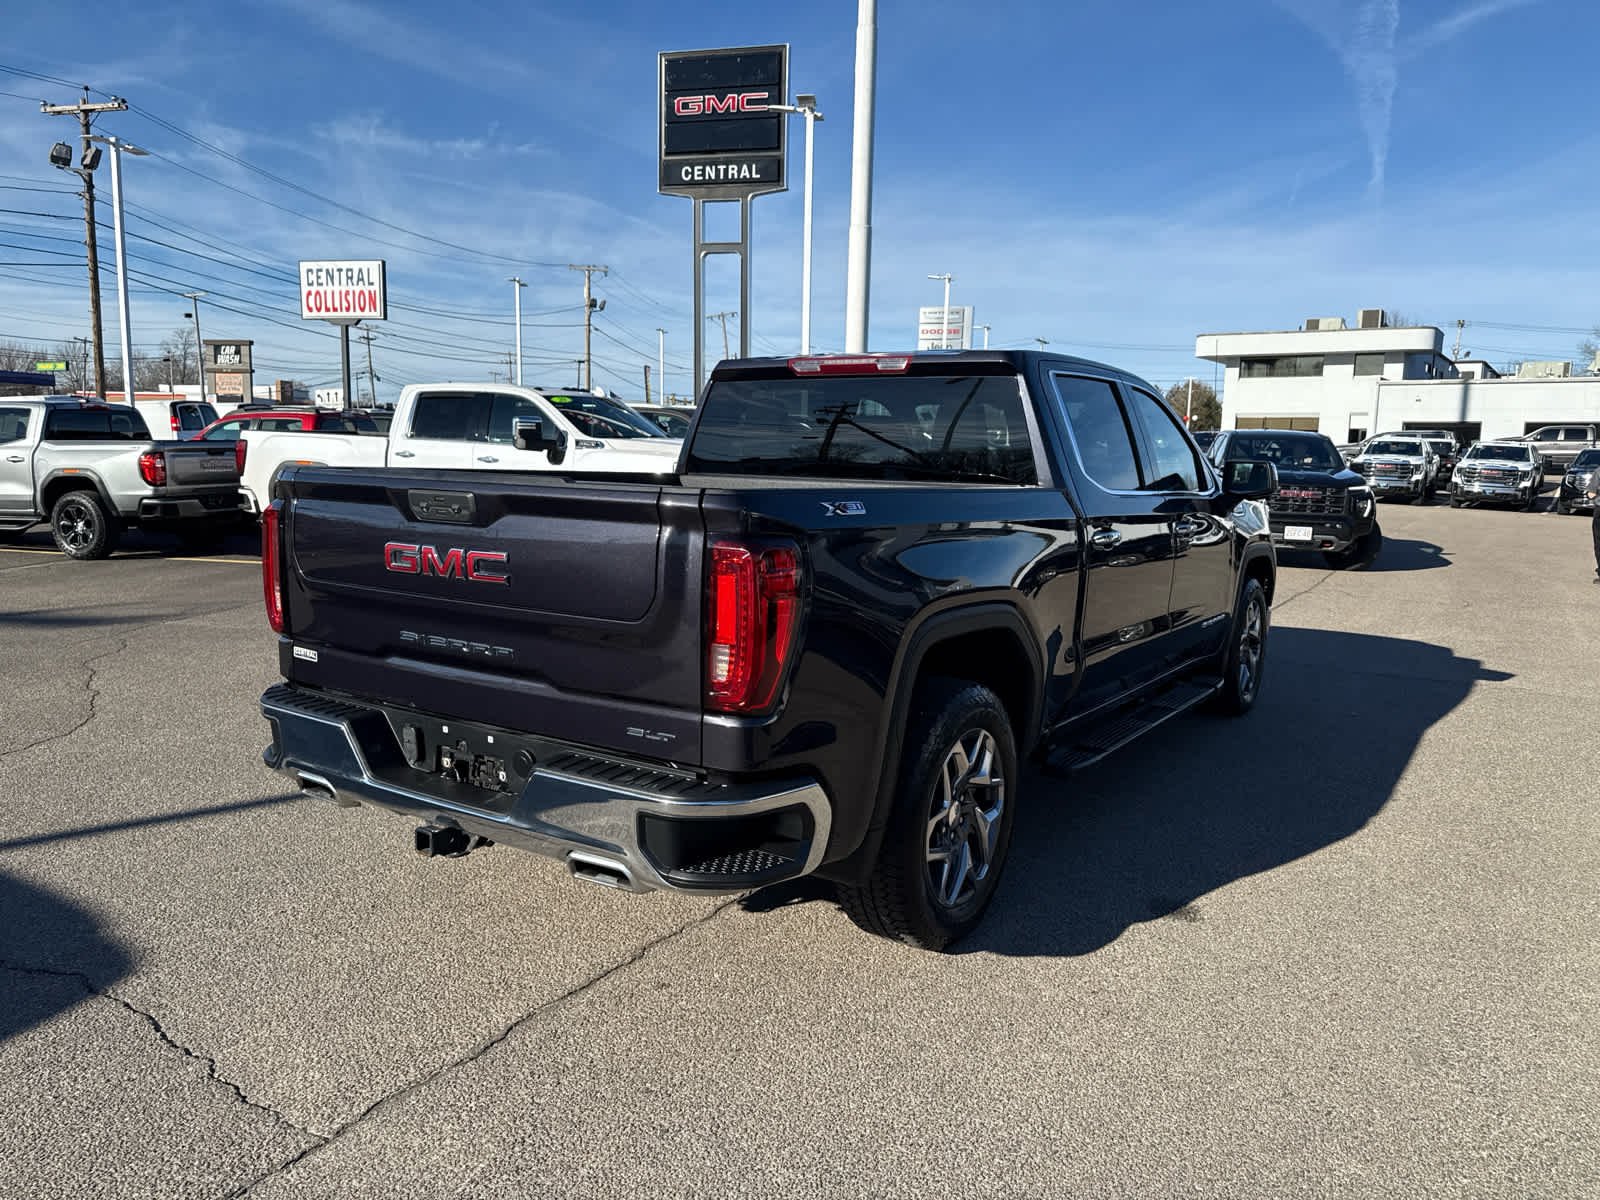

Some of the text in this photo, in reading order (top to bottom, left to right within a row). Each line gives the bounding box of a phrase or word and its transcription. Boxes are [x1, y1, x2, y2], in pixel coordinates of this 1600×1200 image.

[674, 92, 768, 115] GMC
[681, 163, 760, 181] CENTRAL
[306, 267, 374, 286] CENTRAL
[305, 289, 377, 313] COLLISION
[217, 354, 240, 365] WASH
[221, 345, 236, 355] CAR
[384, 541, 510, 585] GMC
[400, 630, 514, 659] SIERRA
[626, 727, 676, 743] SLT
